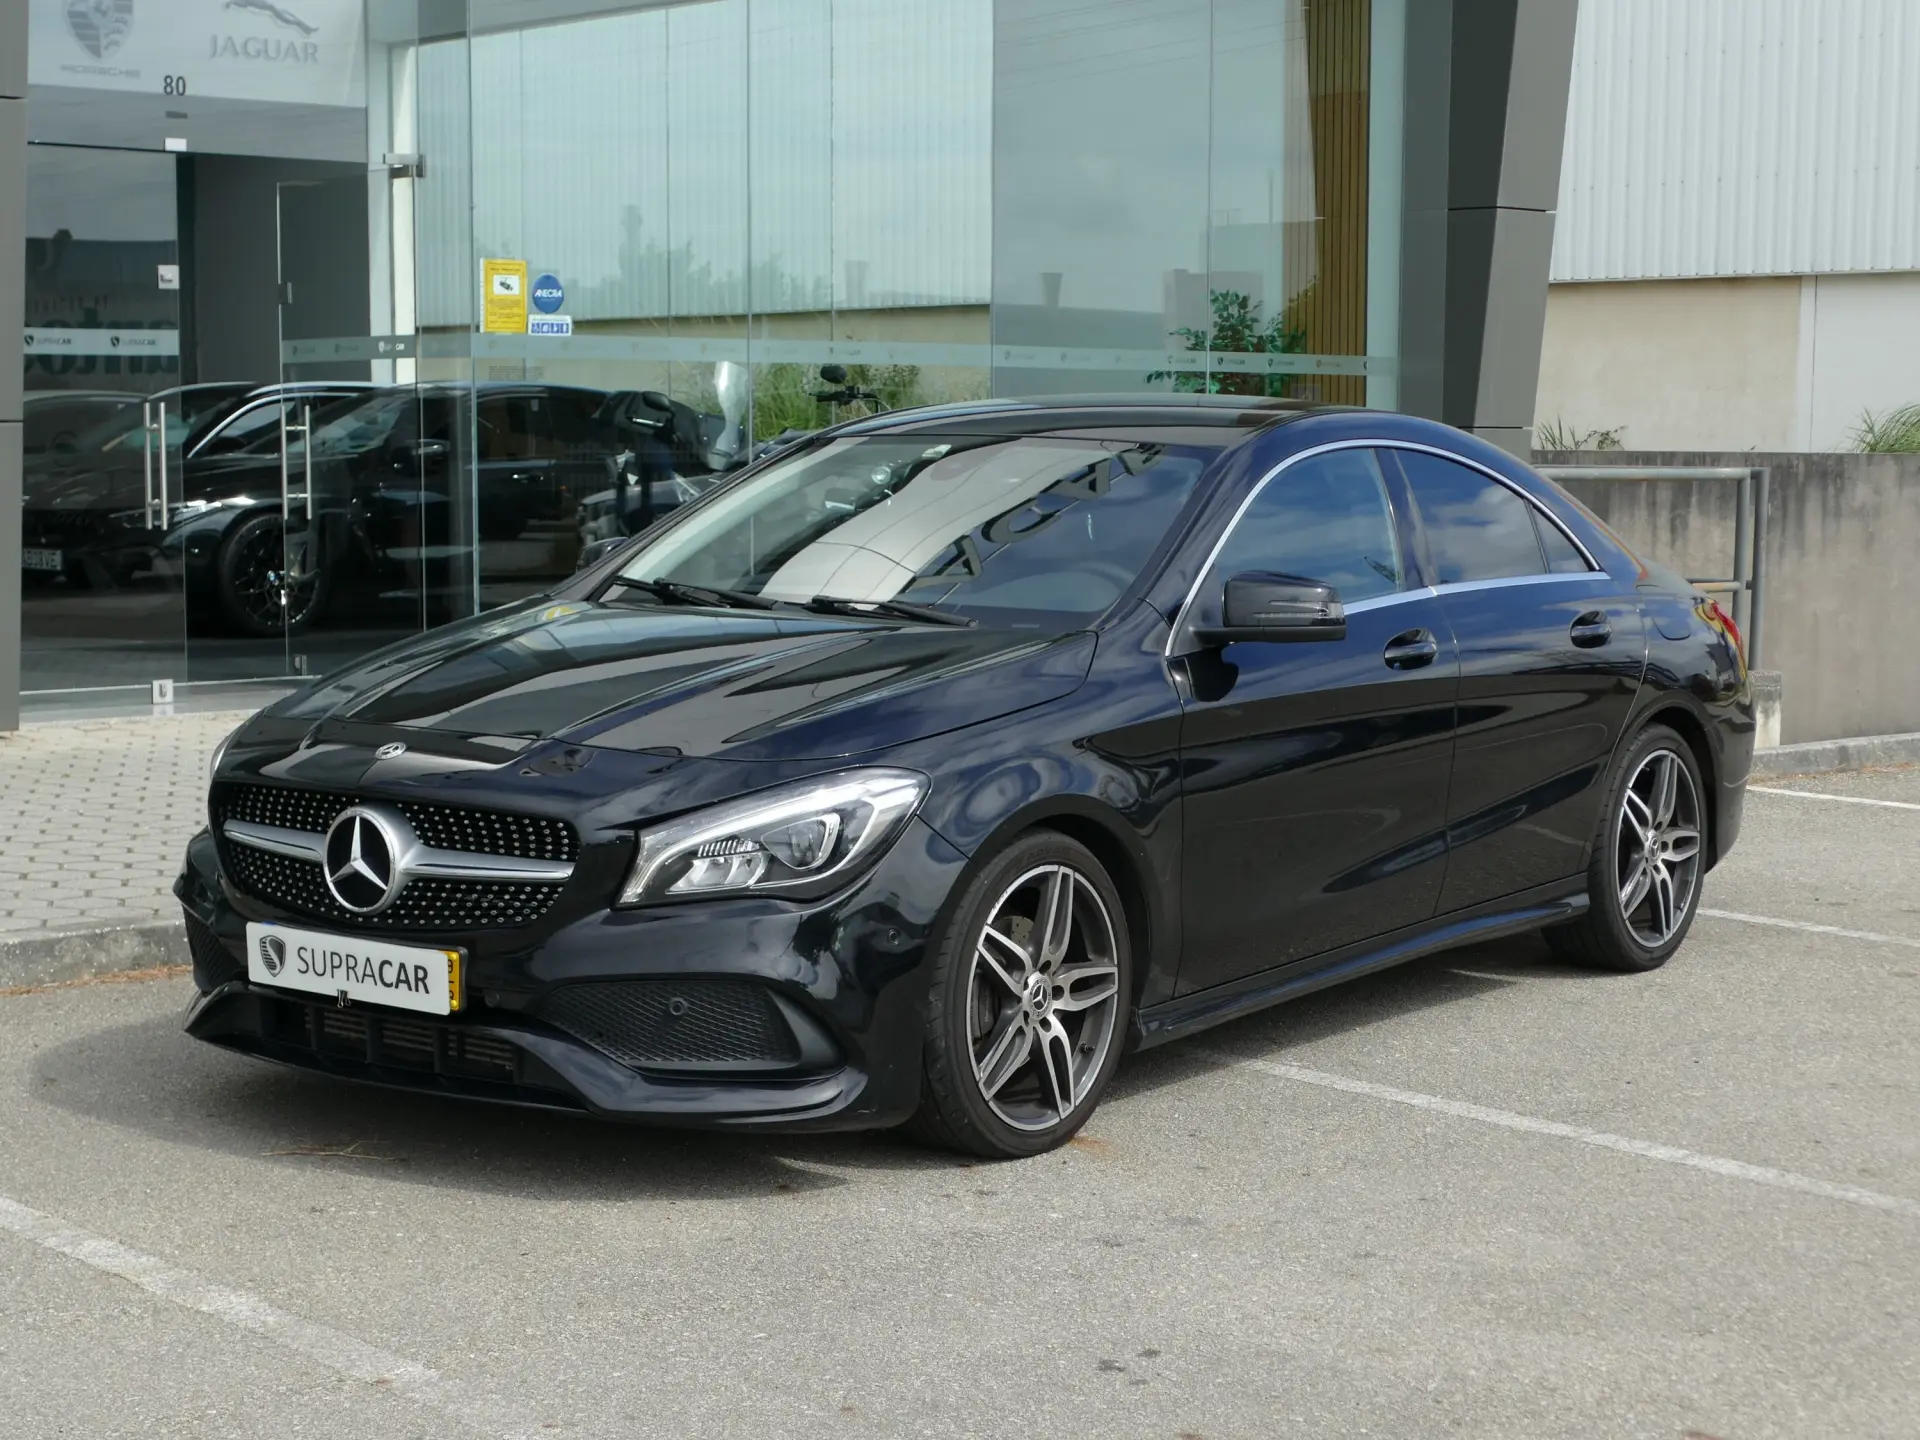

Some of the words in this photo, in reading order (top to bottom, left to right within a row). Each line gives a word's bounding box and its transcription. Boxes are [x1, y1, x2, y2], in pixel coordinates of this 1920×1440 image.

[208, 34, 319, 65] JAGUAR
[60, 63, 141, 79] PORSCHE
[163, 74, 187, 97] 80
[297, 945, 431, 995] SUPRACAR
